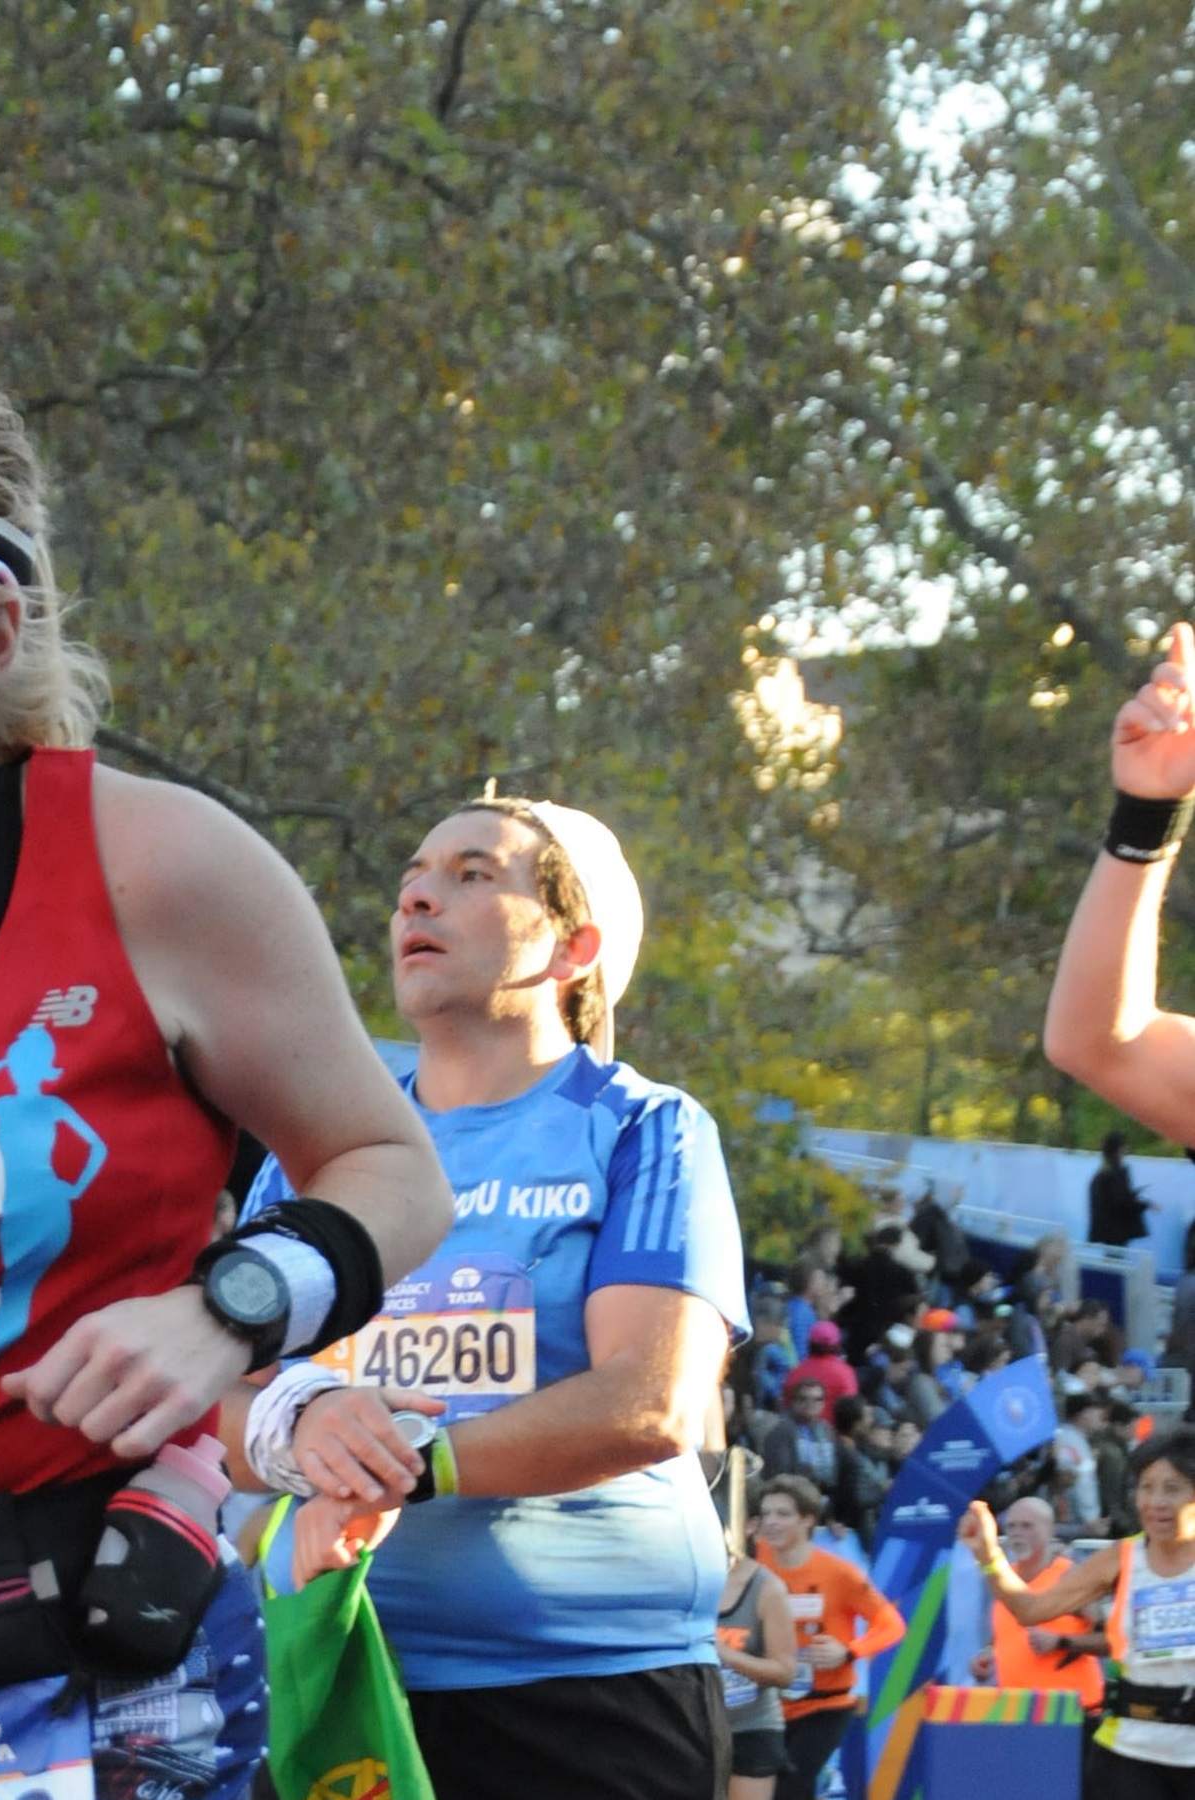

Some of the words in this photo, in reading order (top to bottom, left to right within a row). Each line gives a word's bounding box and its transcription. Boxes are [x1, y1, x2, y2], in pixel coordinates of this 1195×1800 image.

[454, 1179, 501, 1218] OU
[507, 1182, 591, 1219] KIKO
[447, 1291, 485, 1305] TATA
[363, 1322, 516, 1388] 46260
